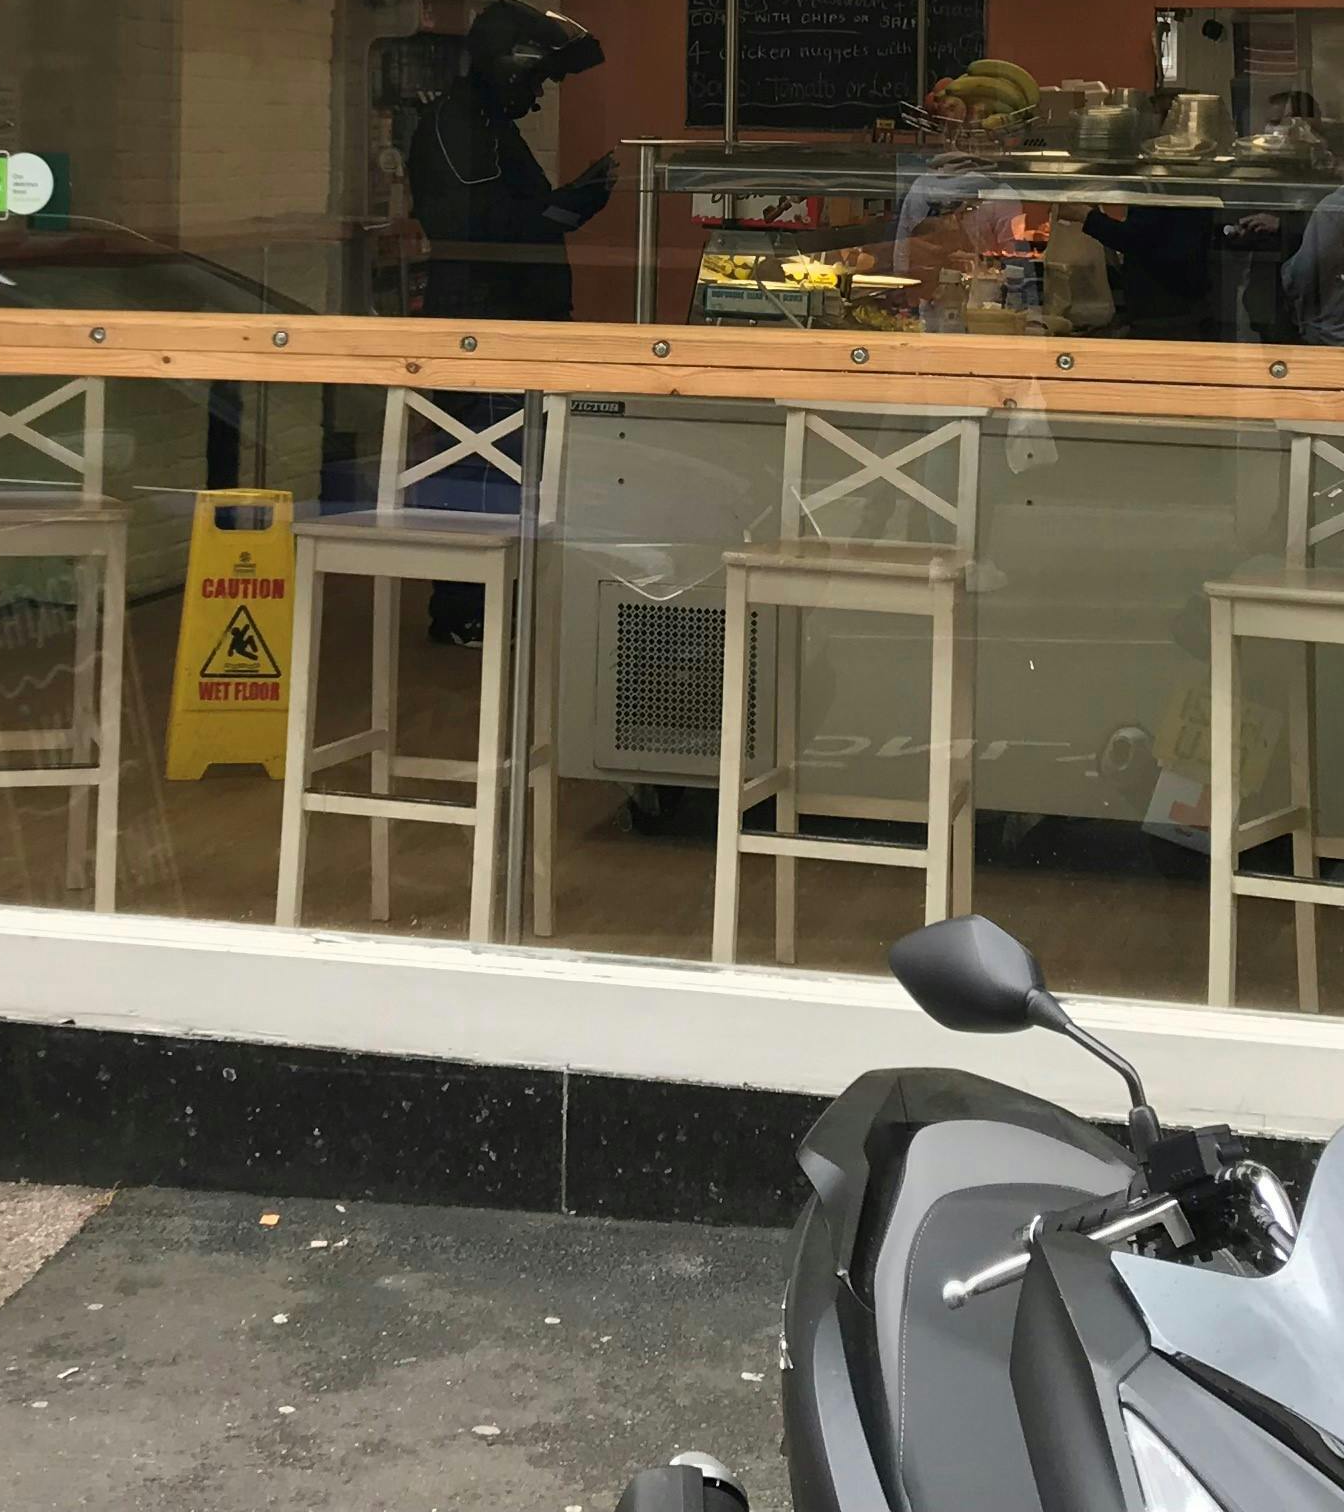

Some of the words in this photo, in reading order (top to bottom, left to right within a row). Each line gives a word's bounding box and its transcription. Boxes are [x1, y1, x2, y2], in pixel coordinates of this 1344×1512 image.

[690, 12, 747, 27] COMS
[755, 11, 792, 25] WITH
[800, 11, 847, 26] CHIPS
[719, 43, 792, 61] cicken
[799, 45, 869, 65] nuggets
[876, 40, 913, 58] with
[763, 71, 837, 102] Tomato
[569, 401, 619, 412] VICTOR
[201, 578, 285, 600] CAUTION
[198, 681, 232, 701] WET
[234, 681, 281, 702] FLOOR
